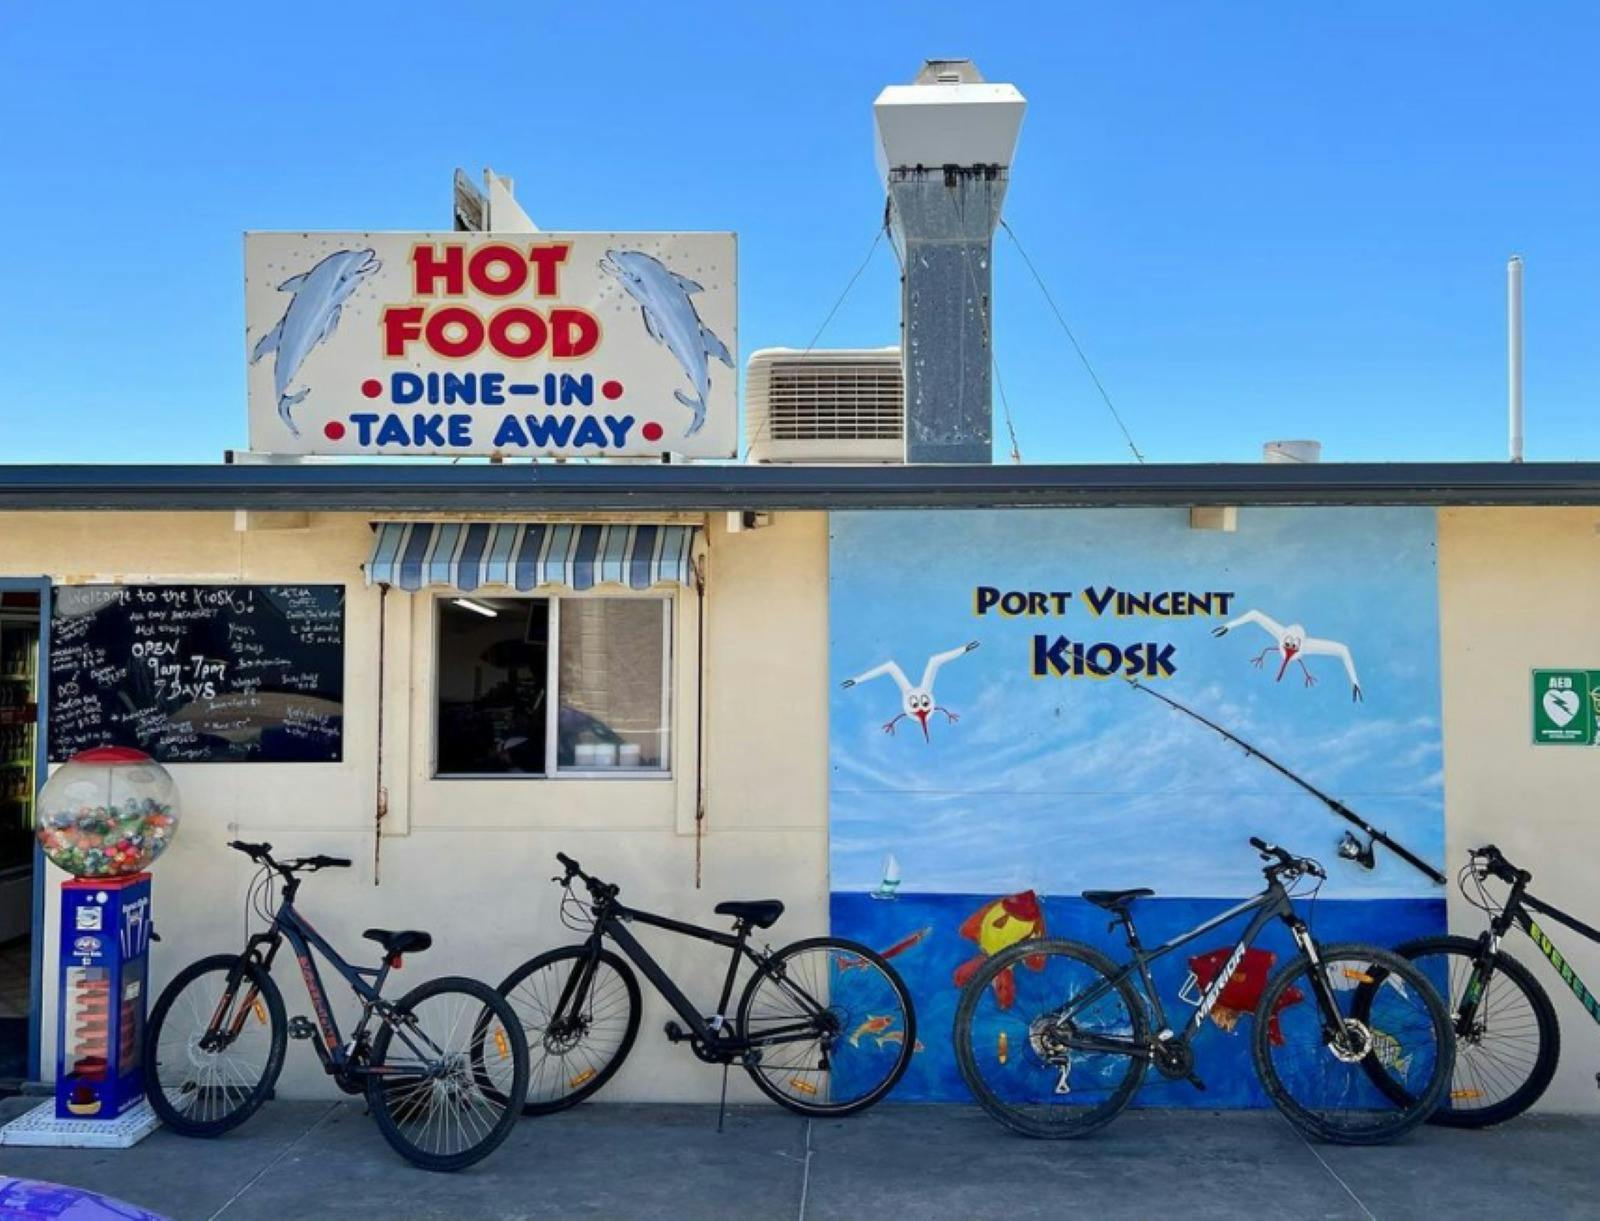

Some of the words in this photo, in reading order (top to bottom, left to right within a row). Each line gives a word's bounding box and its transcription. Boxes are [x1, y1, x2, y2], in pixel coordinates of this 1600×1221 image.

[410, 242, 572, 298] HOT
[383, 307, 600, 360] FOOD
[391, 372, 594, 406] DINE-IN
[349, 414, 473, 447] TAKE
[493, 414, 635, 448] AWAY
[68, 588, 131, 606] Welcome
[136, 588, 156, 602] to
[161, 588, 188, 607] the
[973, 586, 1072, 618] PORT
[1082, 586, 1235, 618] VINCENT
[131, 639, 179, 657] OPEN
[1031, 635, 1177, 681] KIOSK
[154, 679, 167, 700] 7
[166, 678, 216, 703] DAYS
[1549, 676, 1572, 688] AED
